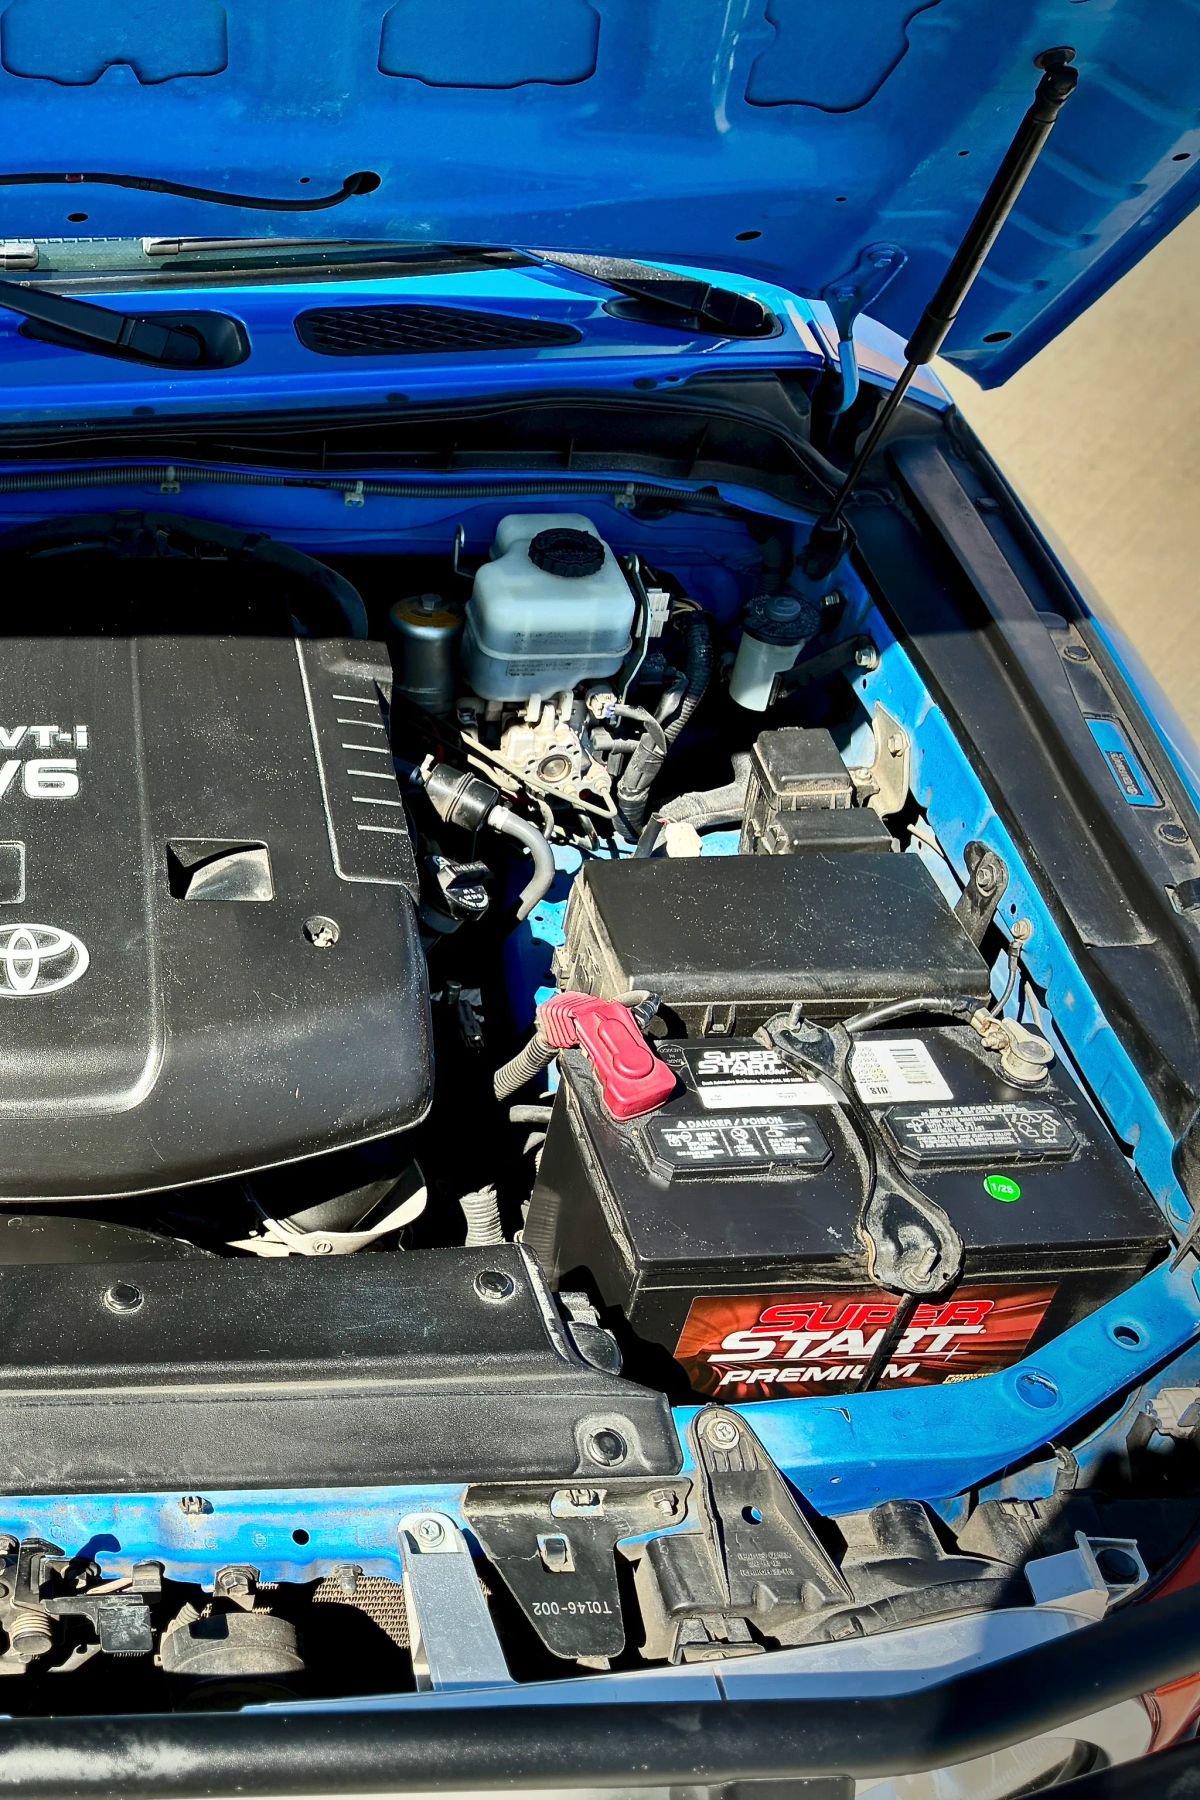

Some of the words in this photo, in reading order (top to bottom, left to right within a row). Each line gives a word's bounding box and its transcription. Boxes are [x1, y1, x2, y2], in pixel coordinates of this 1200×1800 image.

[704, 1051, 778, 1061] SUPER
[698, 1060, 781, 1074] START
[686, 1119, 732, 1128] DANGER
[742, 1116, 783, 1126] POISON
[751, 1300, 995, 1333] SUPER
[707, 1325, 984, 1362] START
[532, 1600, 613, 1615] T0146-002
